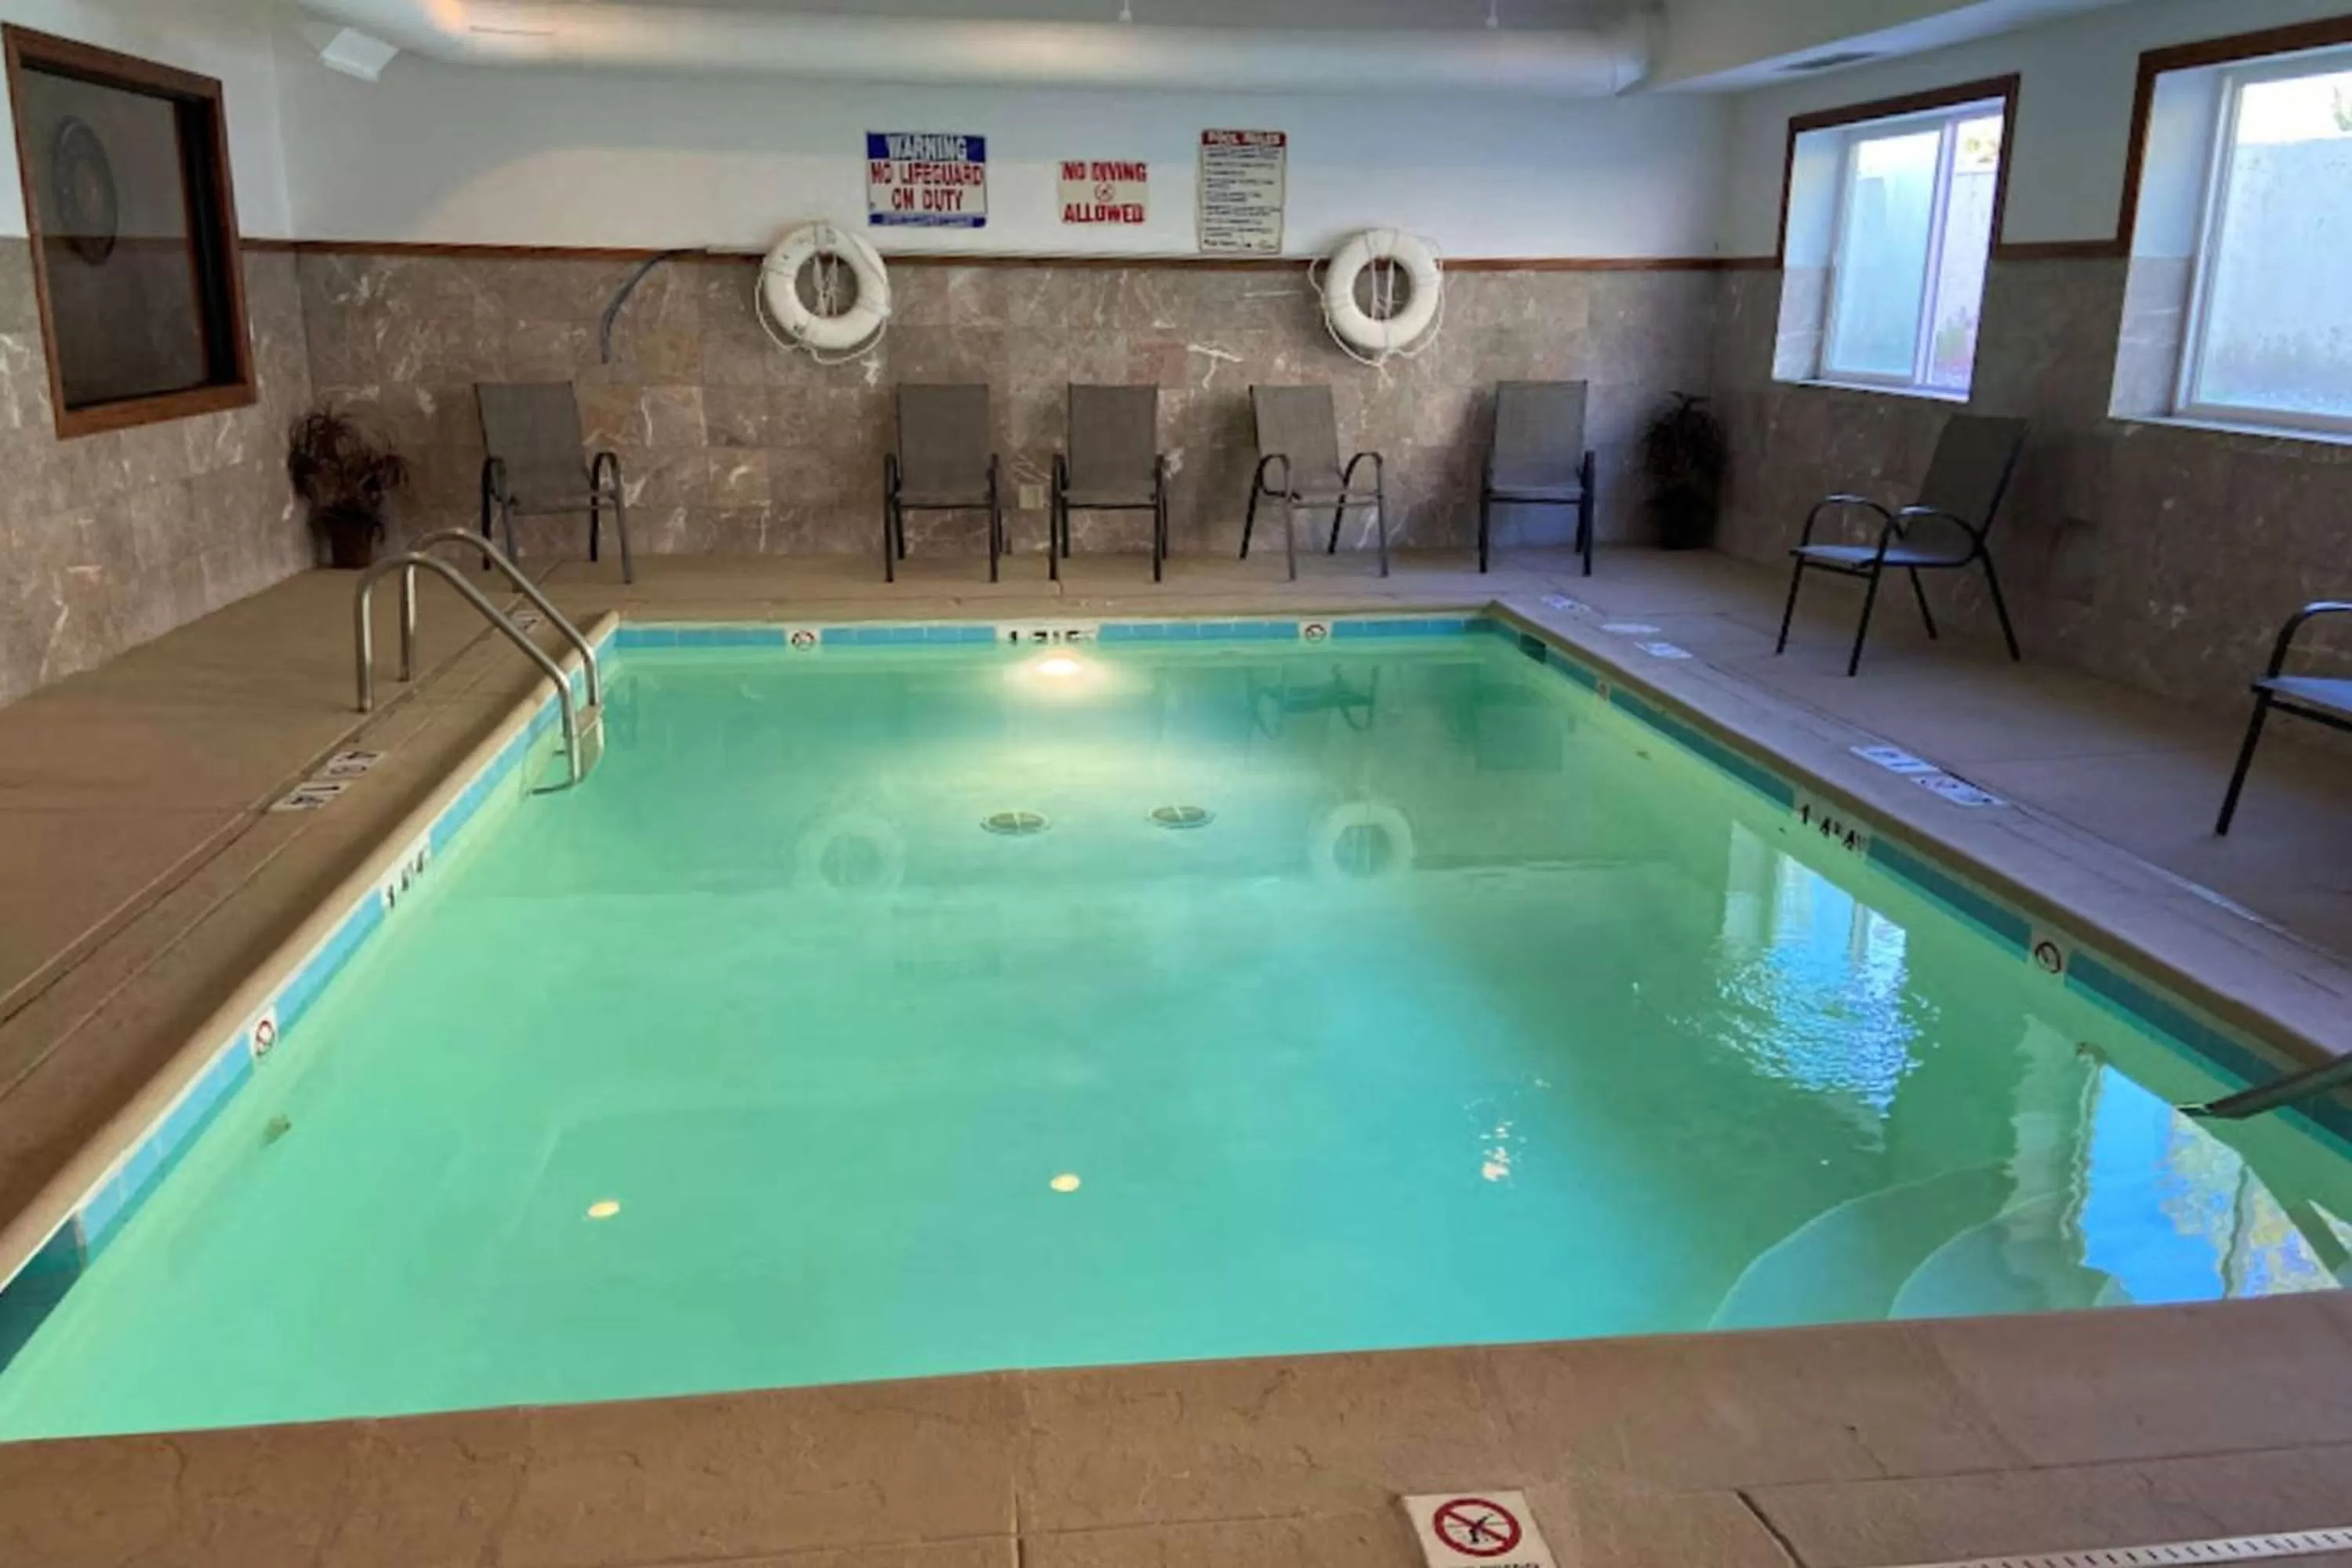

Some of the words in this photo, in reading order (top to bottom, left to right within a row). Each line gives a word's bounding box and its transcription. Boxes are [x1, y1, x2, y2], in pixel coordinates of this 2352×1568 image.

[886, 134, 967, 161] WARNING
[871, 162, 892, 184] NO
[900, 162, 984, 186] LIFEGUARD
[1062, 161, 1085, 180] NO
[1091, 162, 1147, 182] DIVING
[891, 187, 914, 210] ON
[922, 189, 964, 211] DUTY
[1063, 202, 1145, 223] ALLOWED
